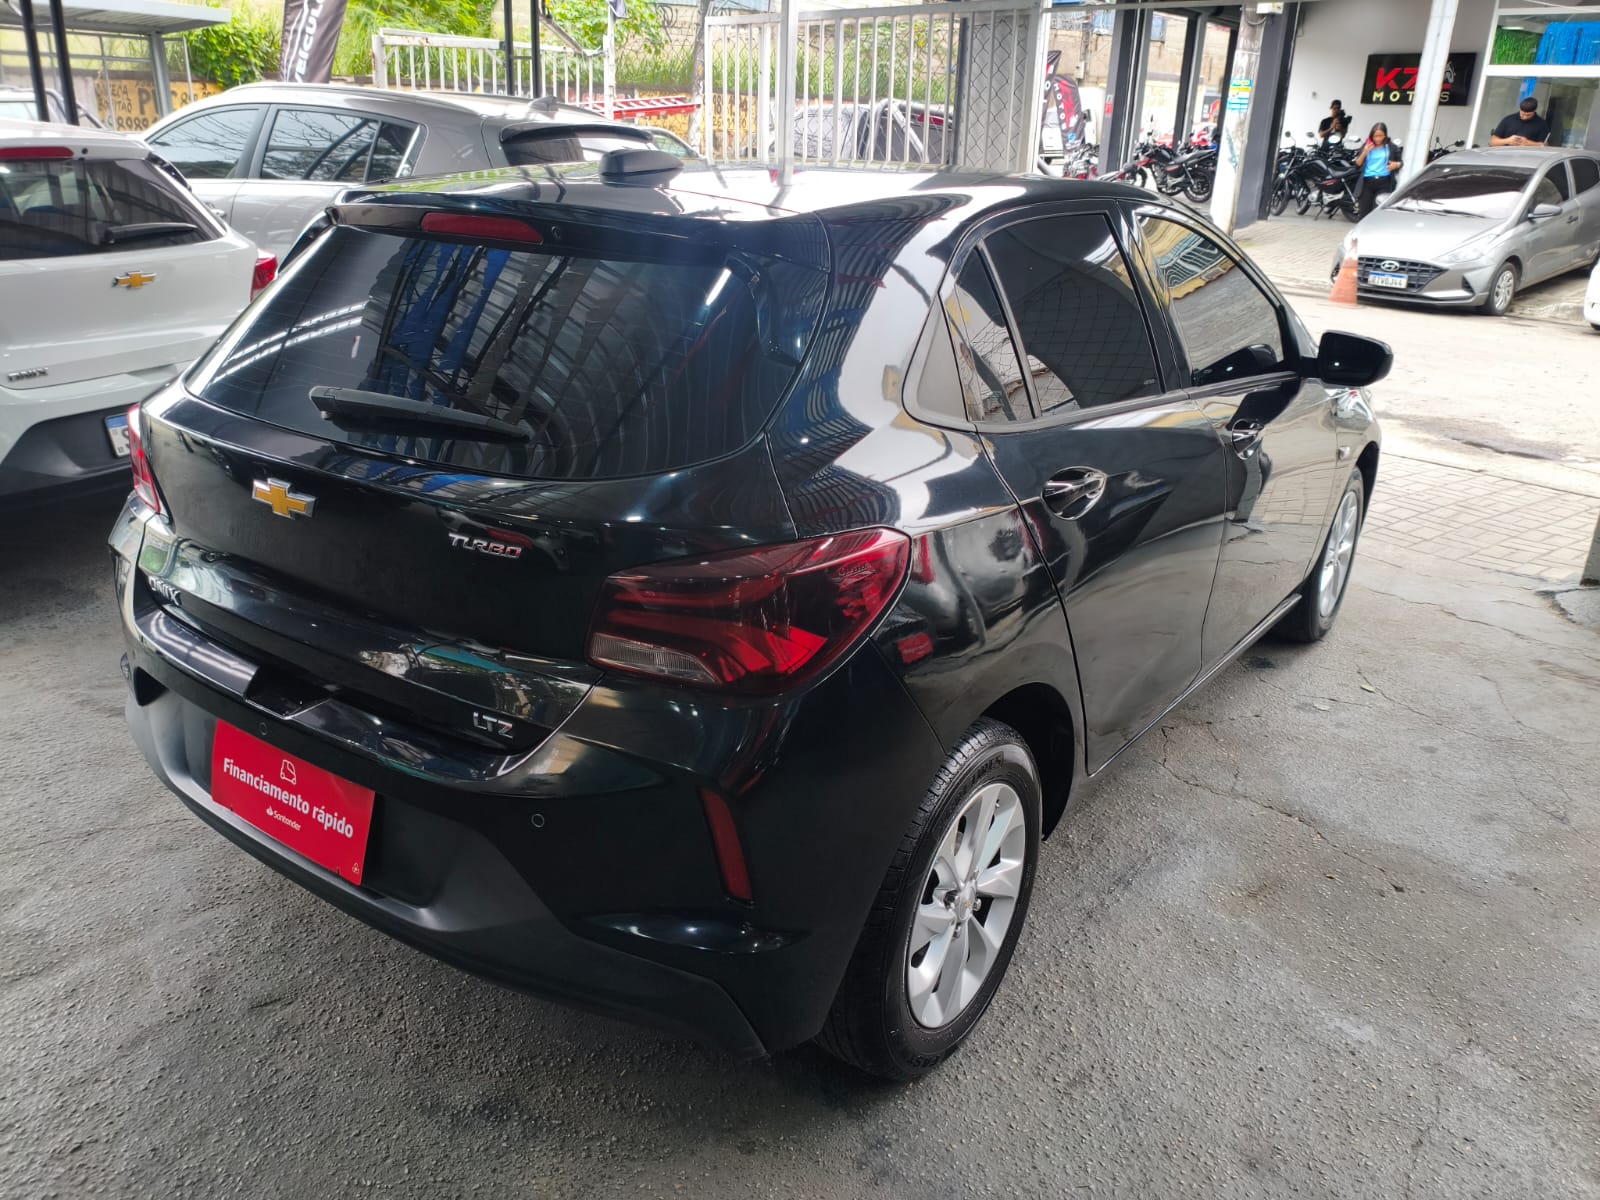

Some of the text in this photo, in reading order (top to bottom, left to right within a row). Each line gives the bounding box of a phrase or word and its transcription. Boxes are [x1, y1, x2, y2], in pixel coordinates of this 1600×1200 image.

[1372, 91, 1450, 102] MOTS
[448, 532, 522, 559] TURBO
[148, 575, 181, 606] ONIX
[473, 711, 513, 739] LTZ
[223, 757, 354, 839] Financiamento rápido
[273, 810, 301, 832] Santander
